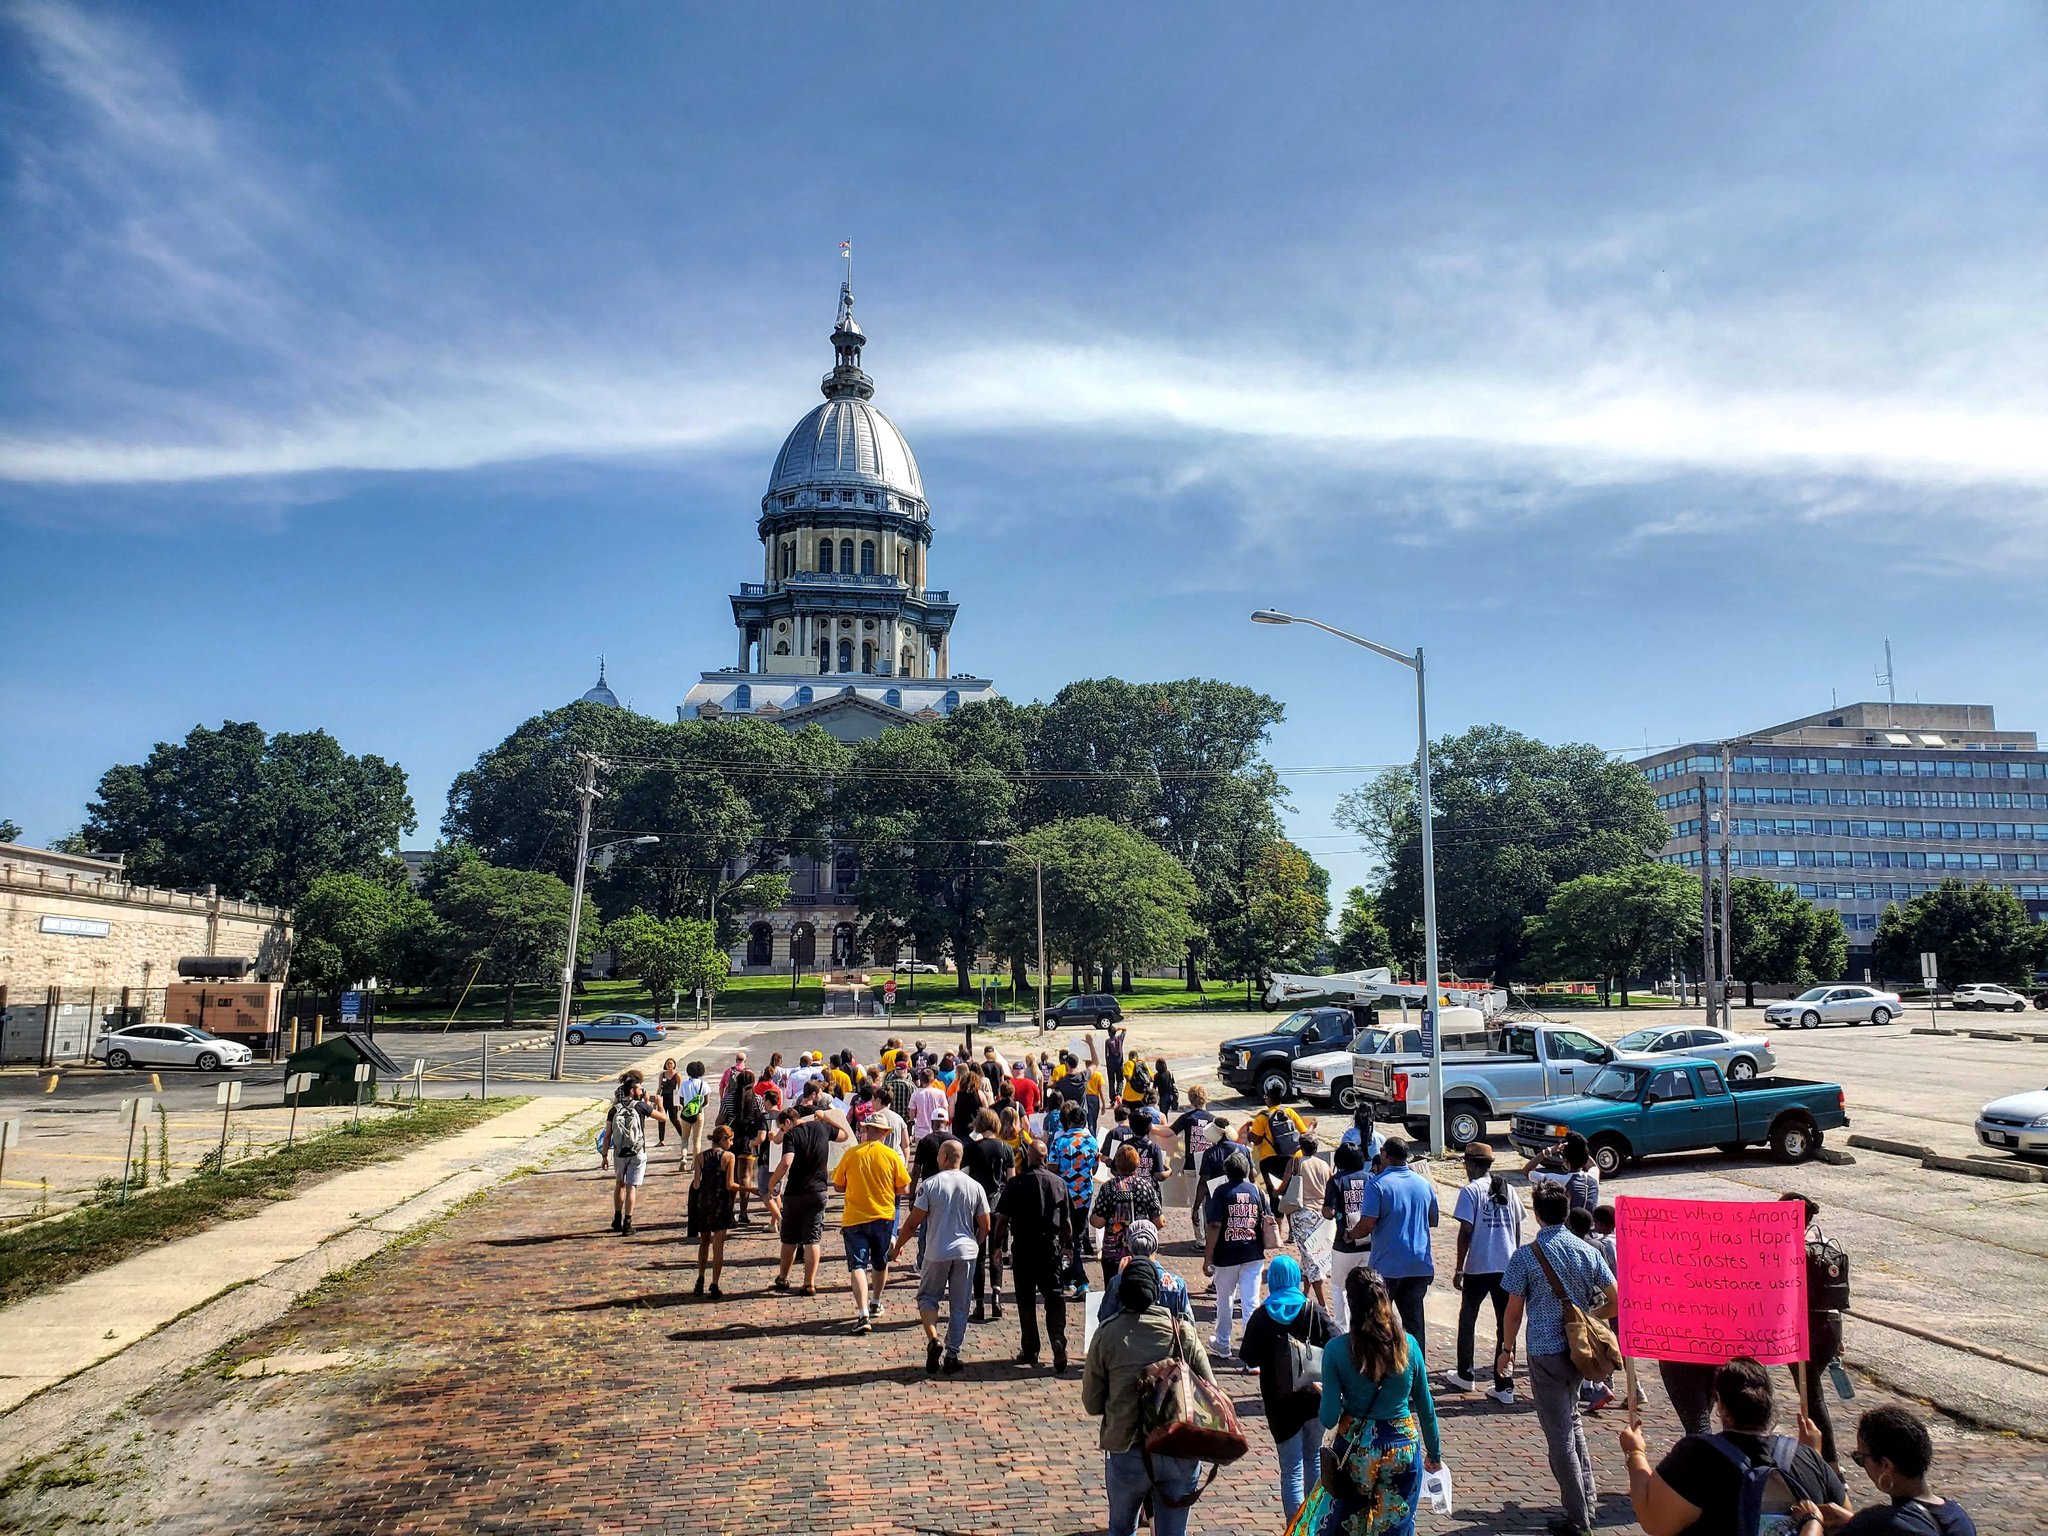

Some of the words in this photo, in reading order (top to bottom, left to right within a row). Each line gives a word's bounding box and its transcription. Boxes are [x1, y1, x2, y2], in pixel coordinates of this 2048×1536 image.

[217, 998, 234, 1007] CAT
[1228, 1204, 1258, 1217] PEOPLE
[1620, 1199, 1679, 1227] Anyone
[1683, 1206, 1724, 1222] Who
[1732, 1209, 1743, 1223] is
[1748, 1208, 1799, 1230] Among
[1619, 1223, 1648, 1239] the
[1653, 1225, 1701, 1251] Living
[1709, 1229, 1743, 1245] Has
[1749, 1227, 1792, 1249] Hope
[1640, 1245, 1749, 1270] Ecclesiastes
[1759, 1252, 1780, 1268] 9:4
[1630, 1265, 1675, 1287] Give
[1683, 1272, 1763, 1290] Substance
[1769, 1276, 1802, 1290] users
[1621, 1296, 1653, 1311] and
[1660, 1301, 1738, 1323] mentally
[1747, 1301, 1764, 1318] ill
[1776, 1303, 1789, 1316] a
[1701, 1321, 1725, 1341] to
[1632, 1335, 1671, 1351] end
[1688, 1339, 1759, 1358] money
[1765, 1340, 1799, 1356] Bond
